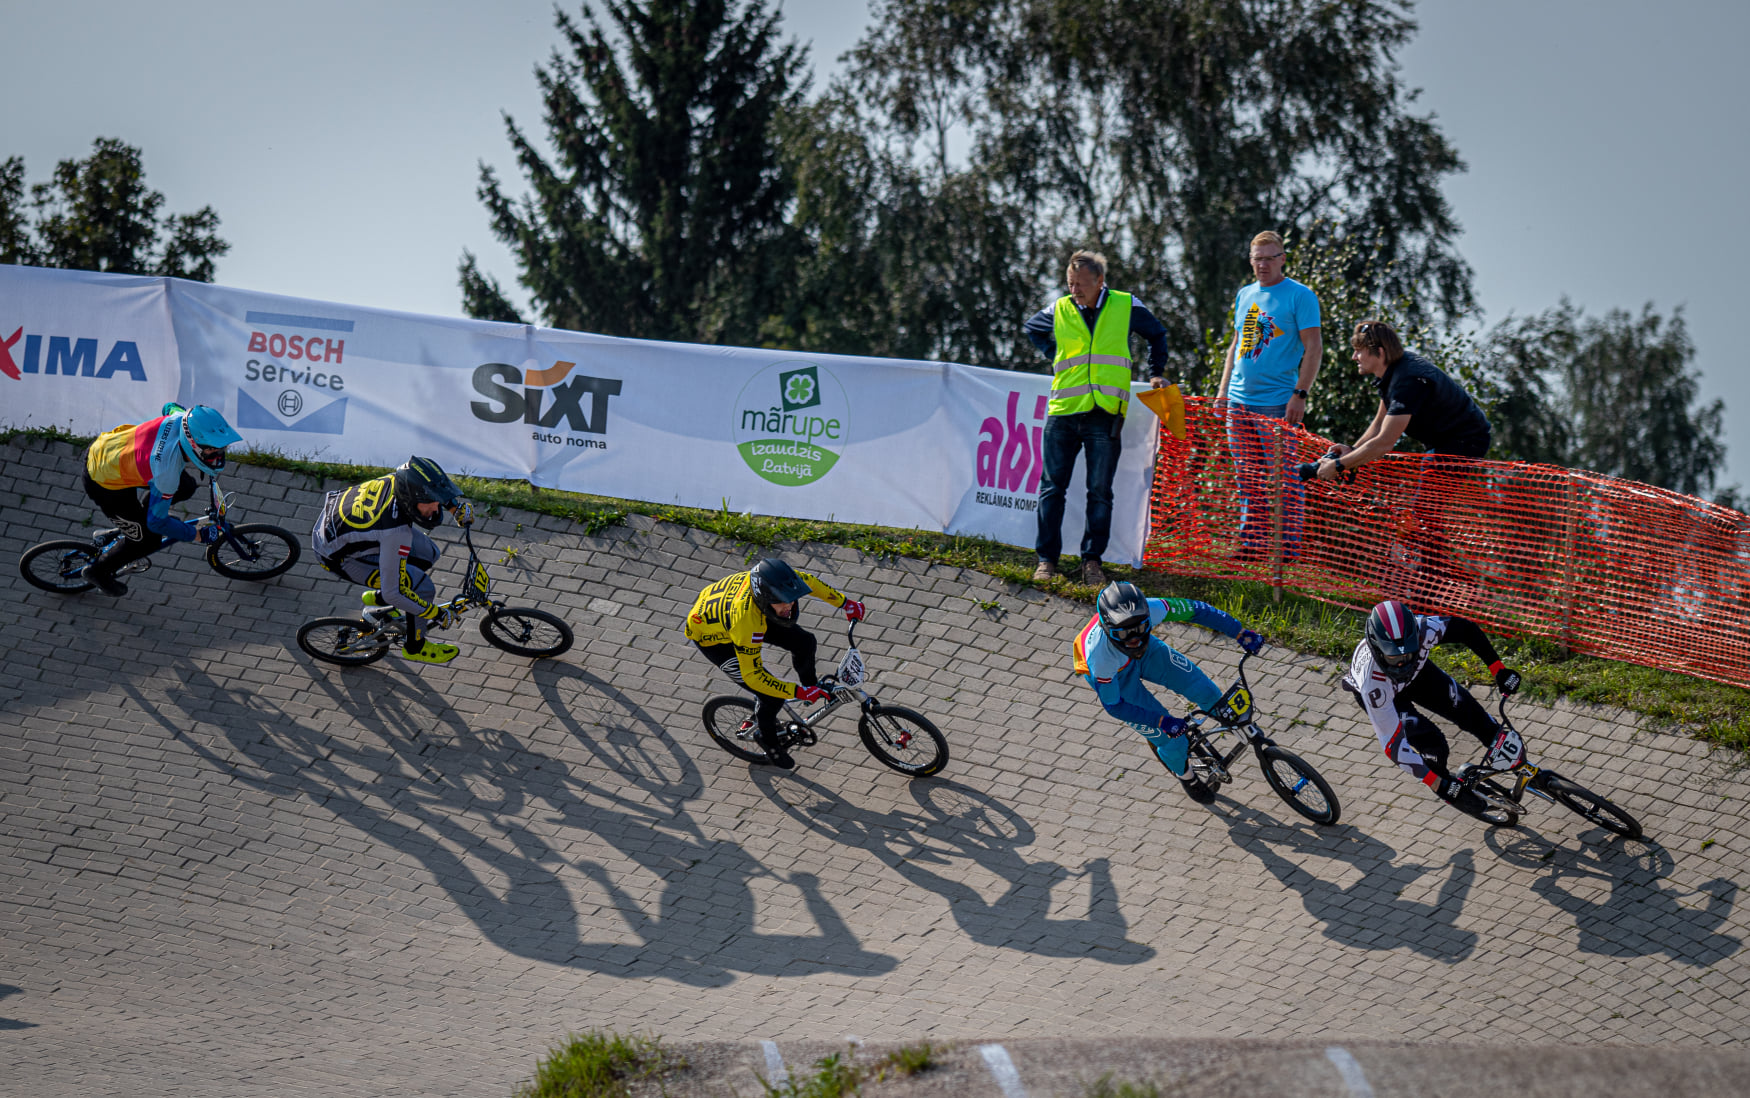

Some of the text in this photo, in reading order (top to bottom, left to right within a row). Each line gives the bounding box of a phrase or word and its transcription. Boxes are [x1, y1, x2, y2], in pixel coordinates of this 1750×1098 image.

[247, 331, 345, 364] BOSCH
[245, 360, 345, 391] Service
[532, 430, 607, 449] auto noma
[751, 441, 822, 462] izaudzis
[476, 570, 489, 592] 12
[1234, 693, 1246, 711] 8
[1498, 737, 1519, 760] 76
